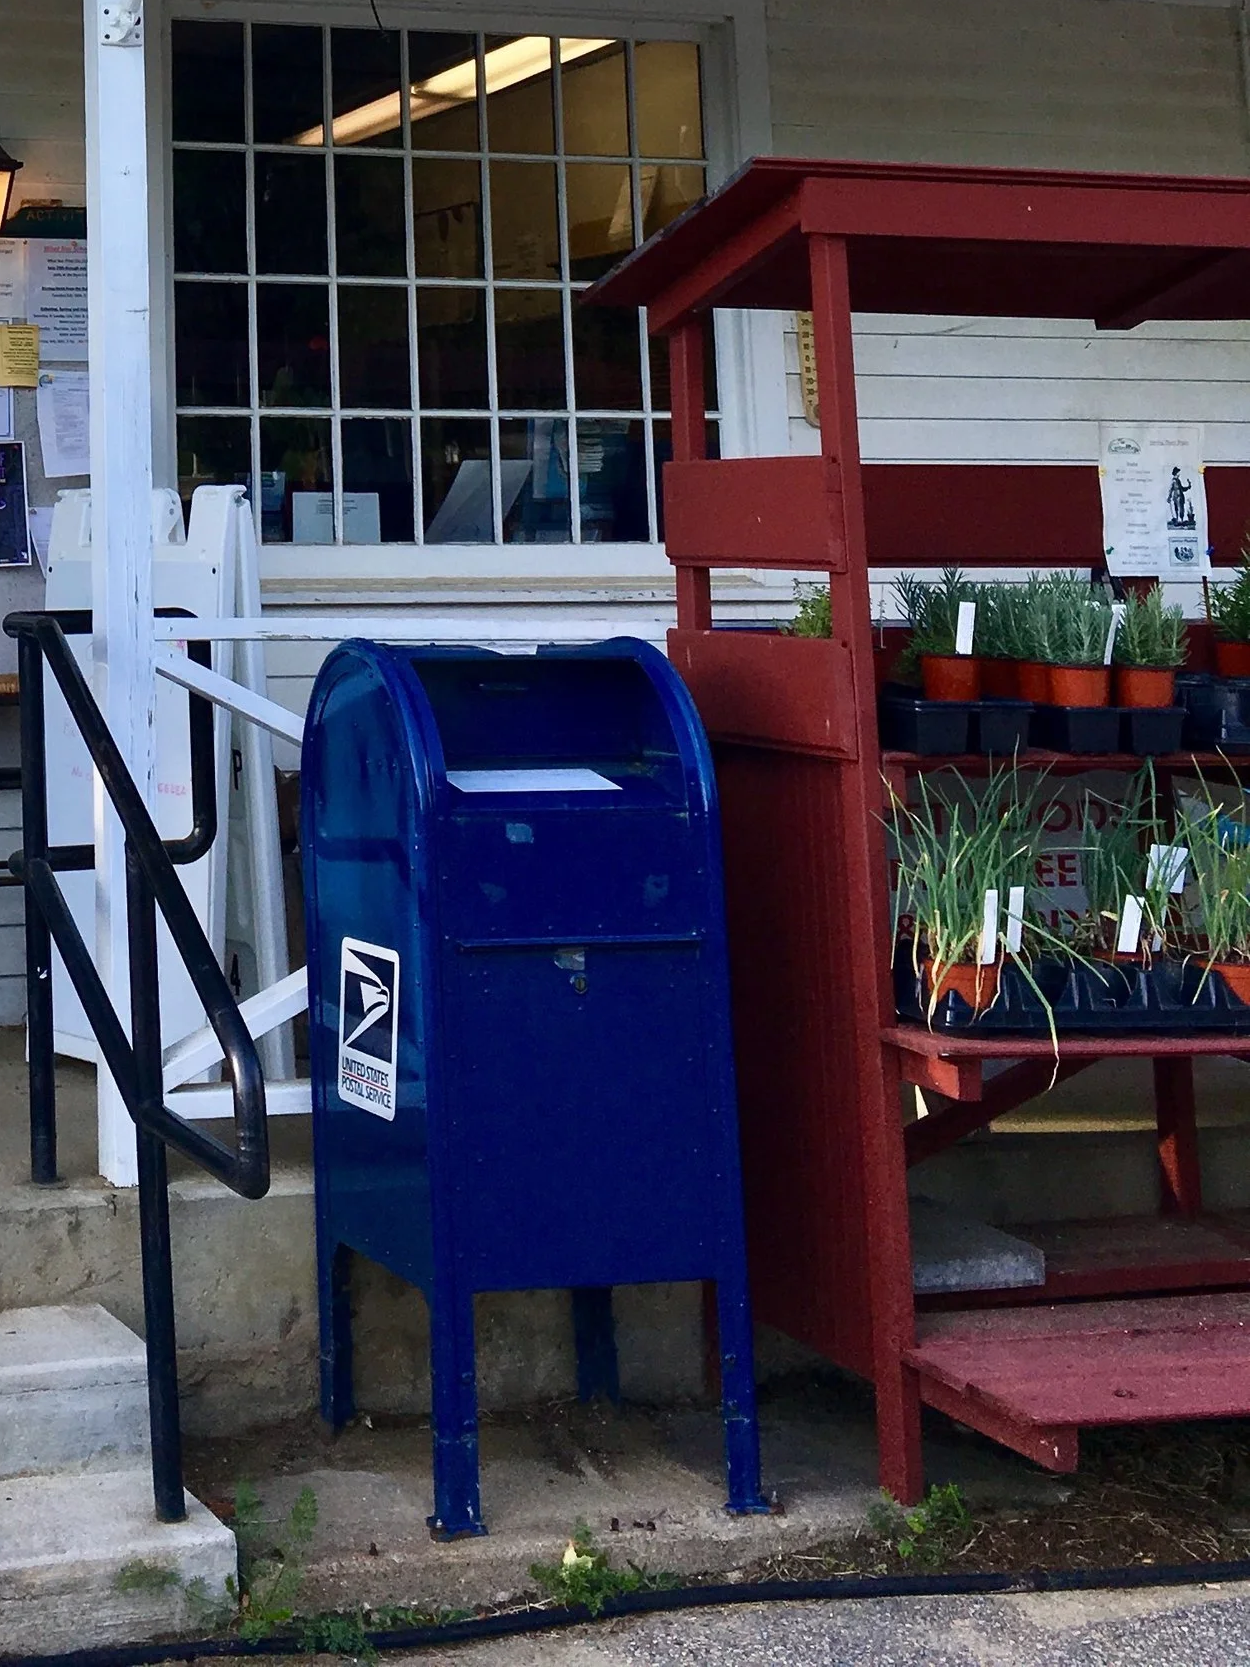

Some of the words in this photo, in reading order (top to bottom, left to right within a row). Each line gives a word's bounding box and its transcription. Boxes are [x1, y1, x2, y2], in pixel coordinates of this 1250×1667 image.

[25, 209, 86, 222] ACTIVIT
[342, 1056, 366, 1078] UNITED
[366, 1067, 389, 1088] STATES
[341, 1074, 365, 1097] POSTAL
[365, 1086, 392, 1110] SERVICE
